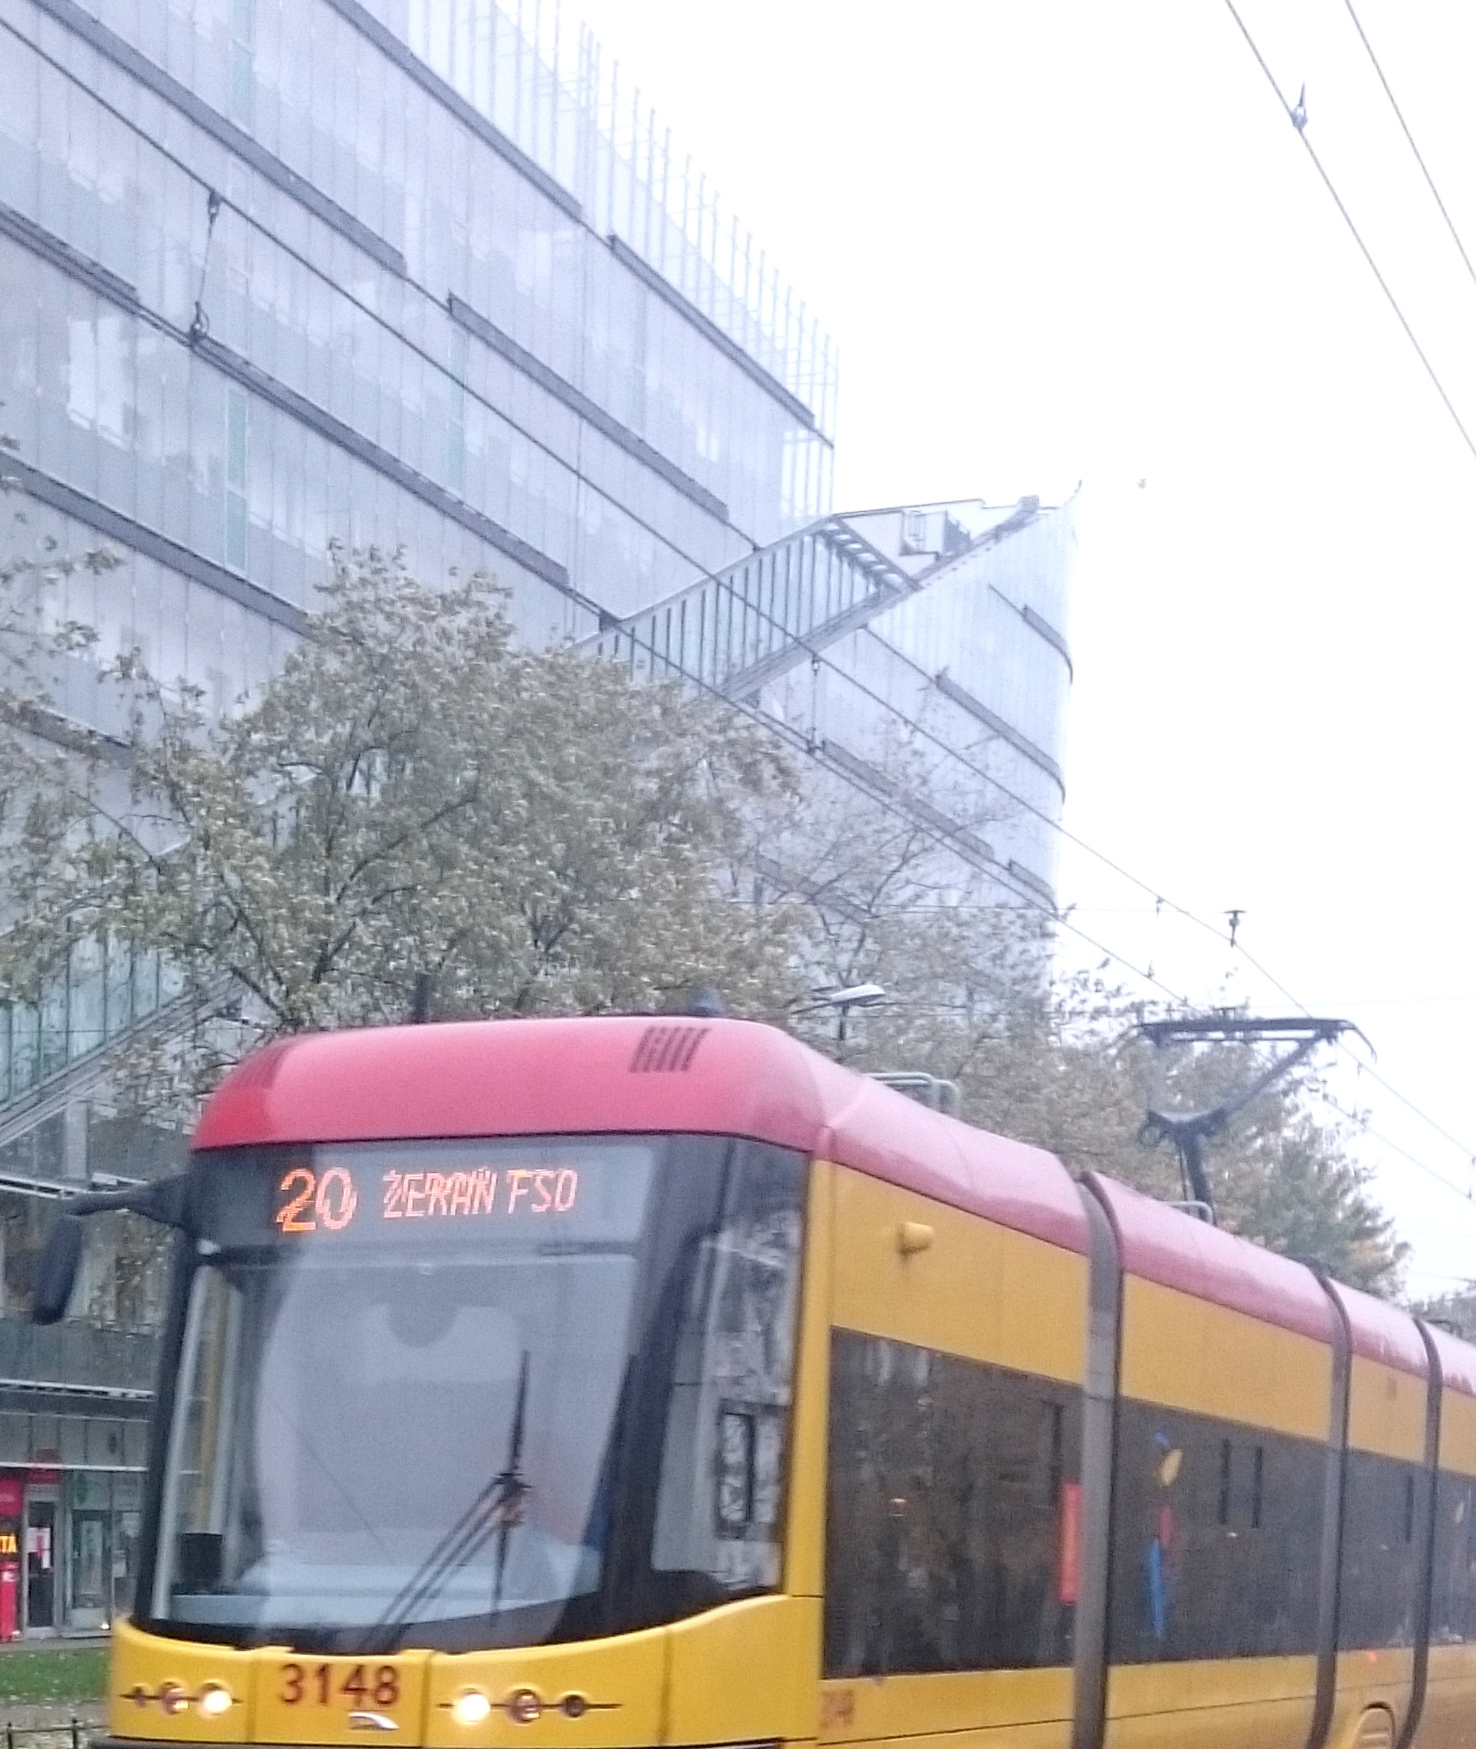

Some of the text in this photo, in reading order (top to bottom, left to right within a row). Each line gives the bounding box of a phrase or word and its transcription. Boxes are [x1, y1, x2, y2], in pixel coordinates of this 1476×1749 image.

[276, 1165, 578, 1232] 20 ŻERAŃ FSO
[280, 1663, 399, 1706] 3148
